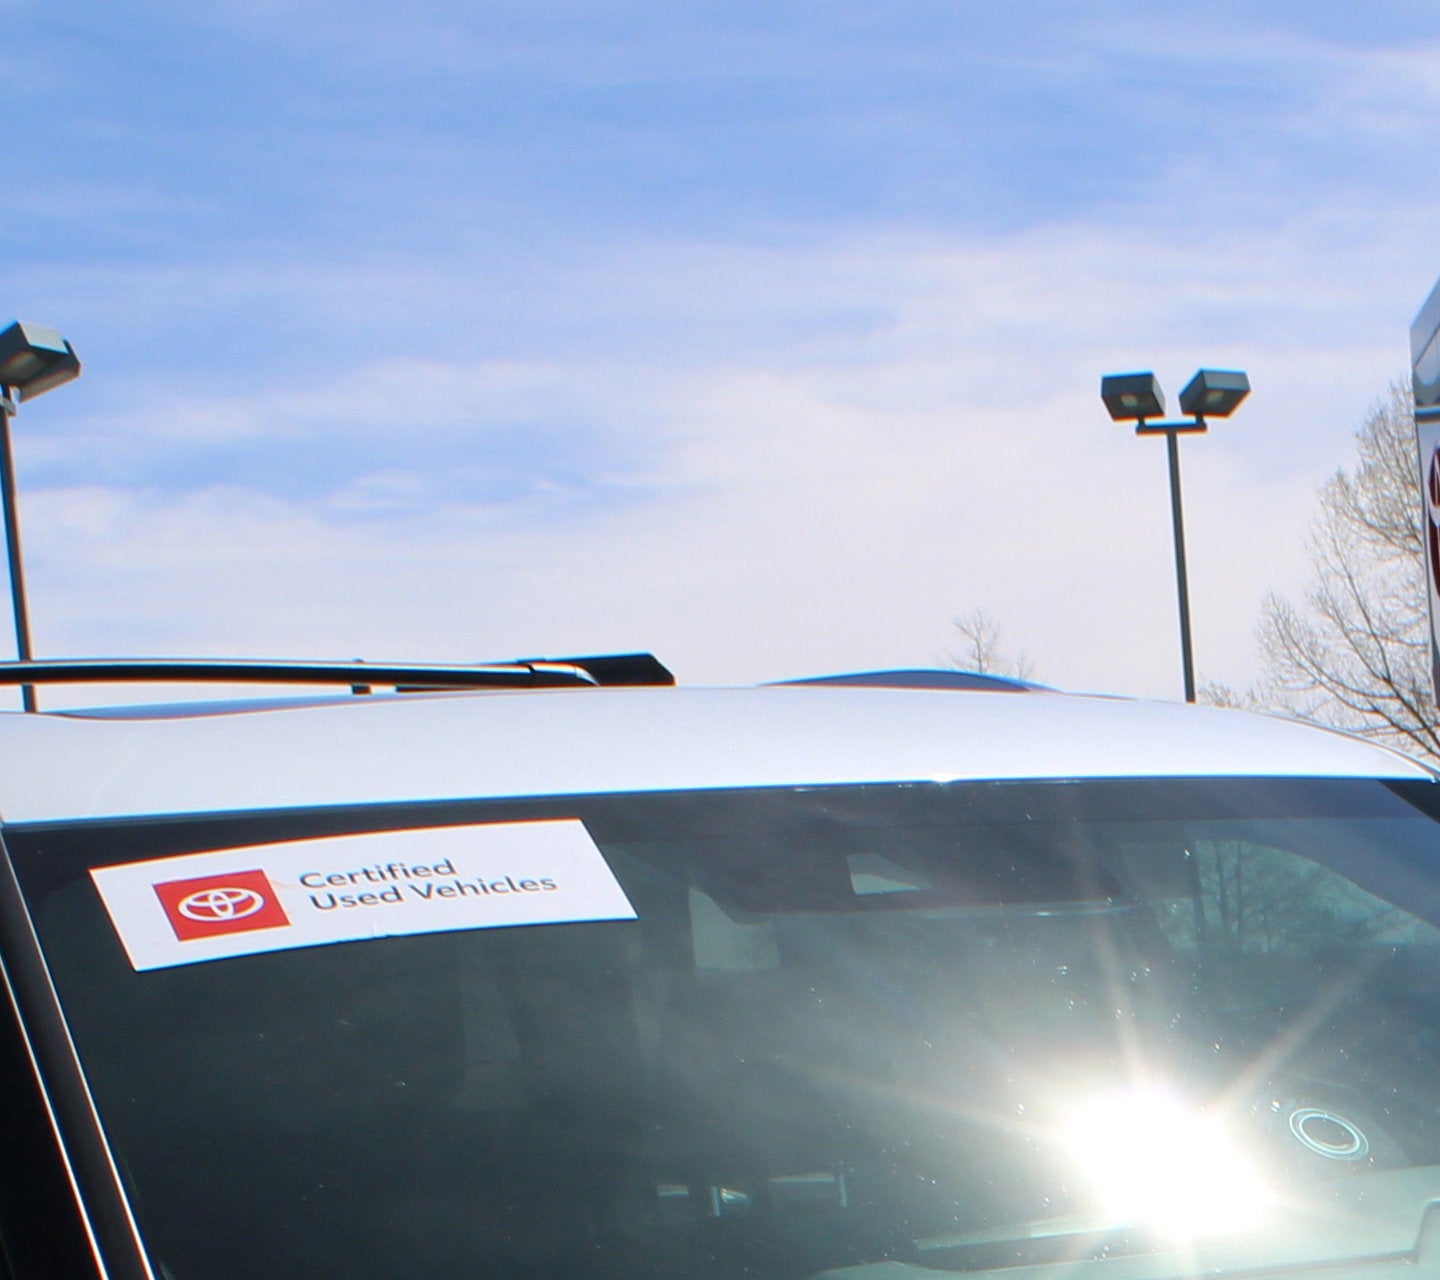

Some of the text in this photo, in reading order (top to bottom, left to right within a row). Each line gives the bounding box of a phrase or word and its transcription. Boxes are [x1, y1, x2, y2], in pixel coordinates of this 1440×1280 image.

[299, 858, 457, 889] Certified
[310, 875, 558, 911] Used Vehicles
